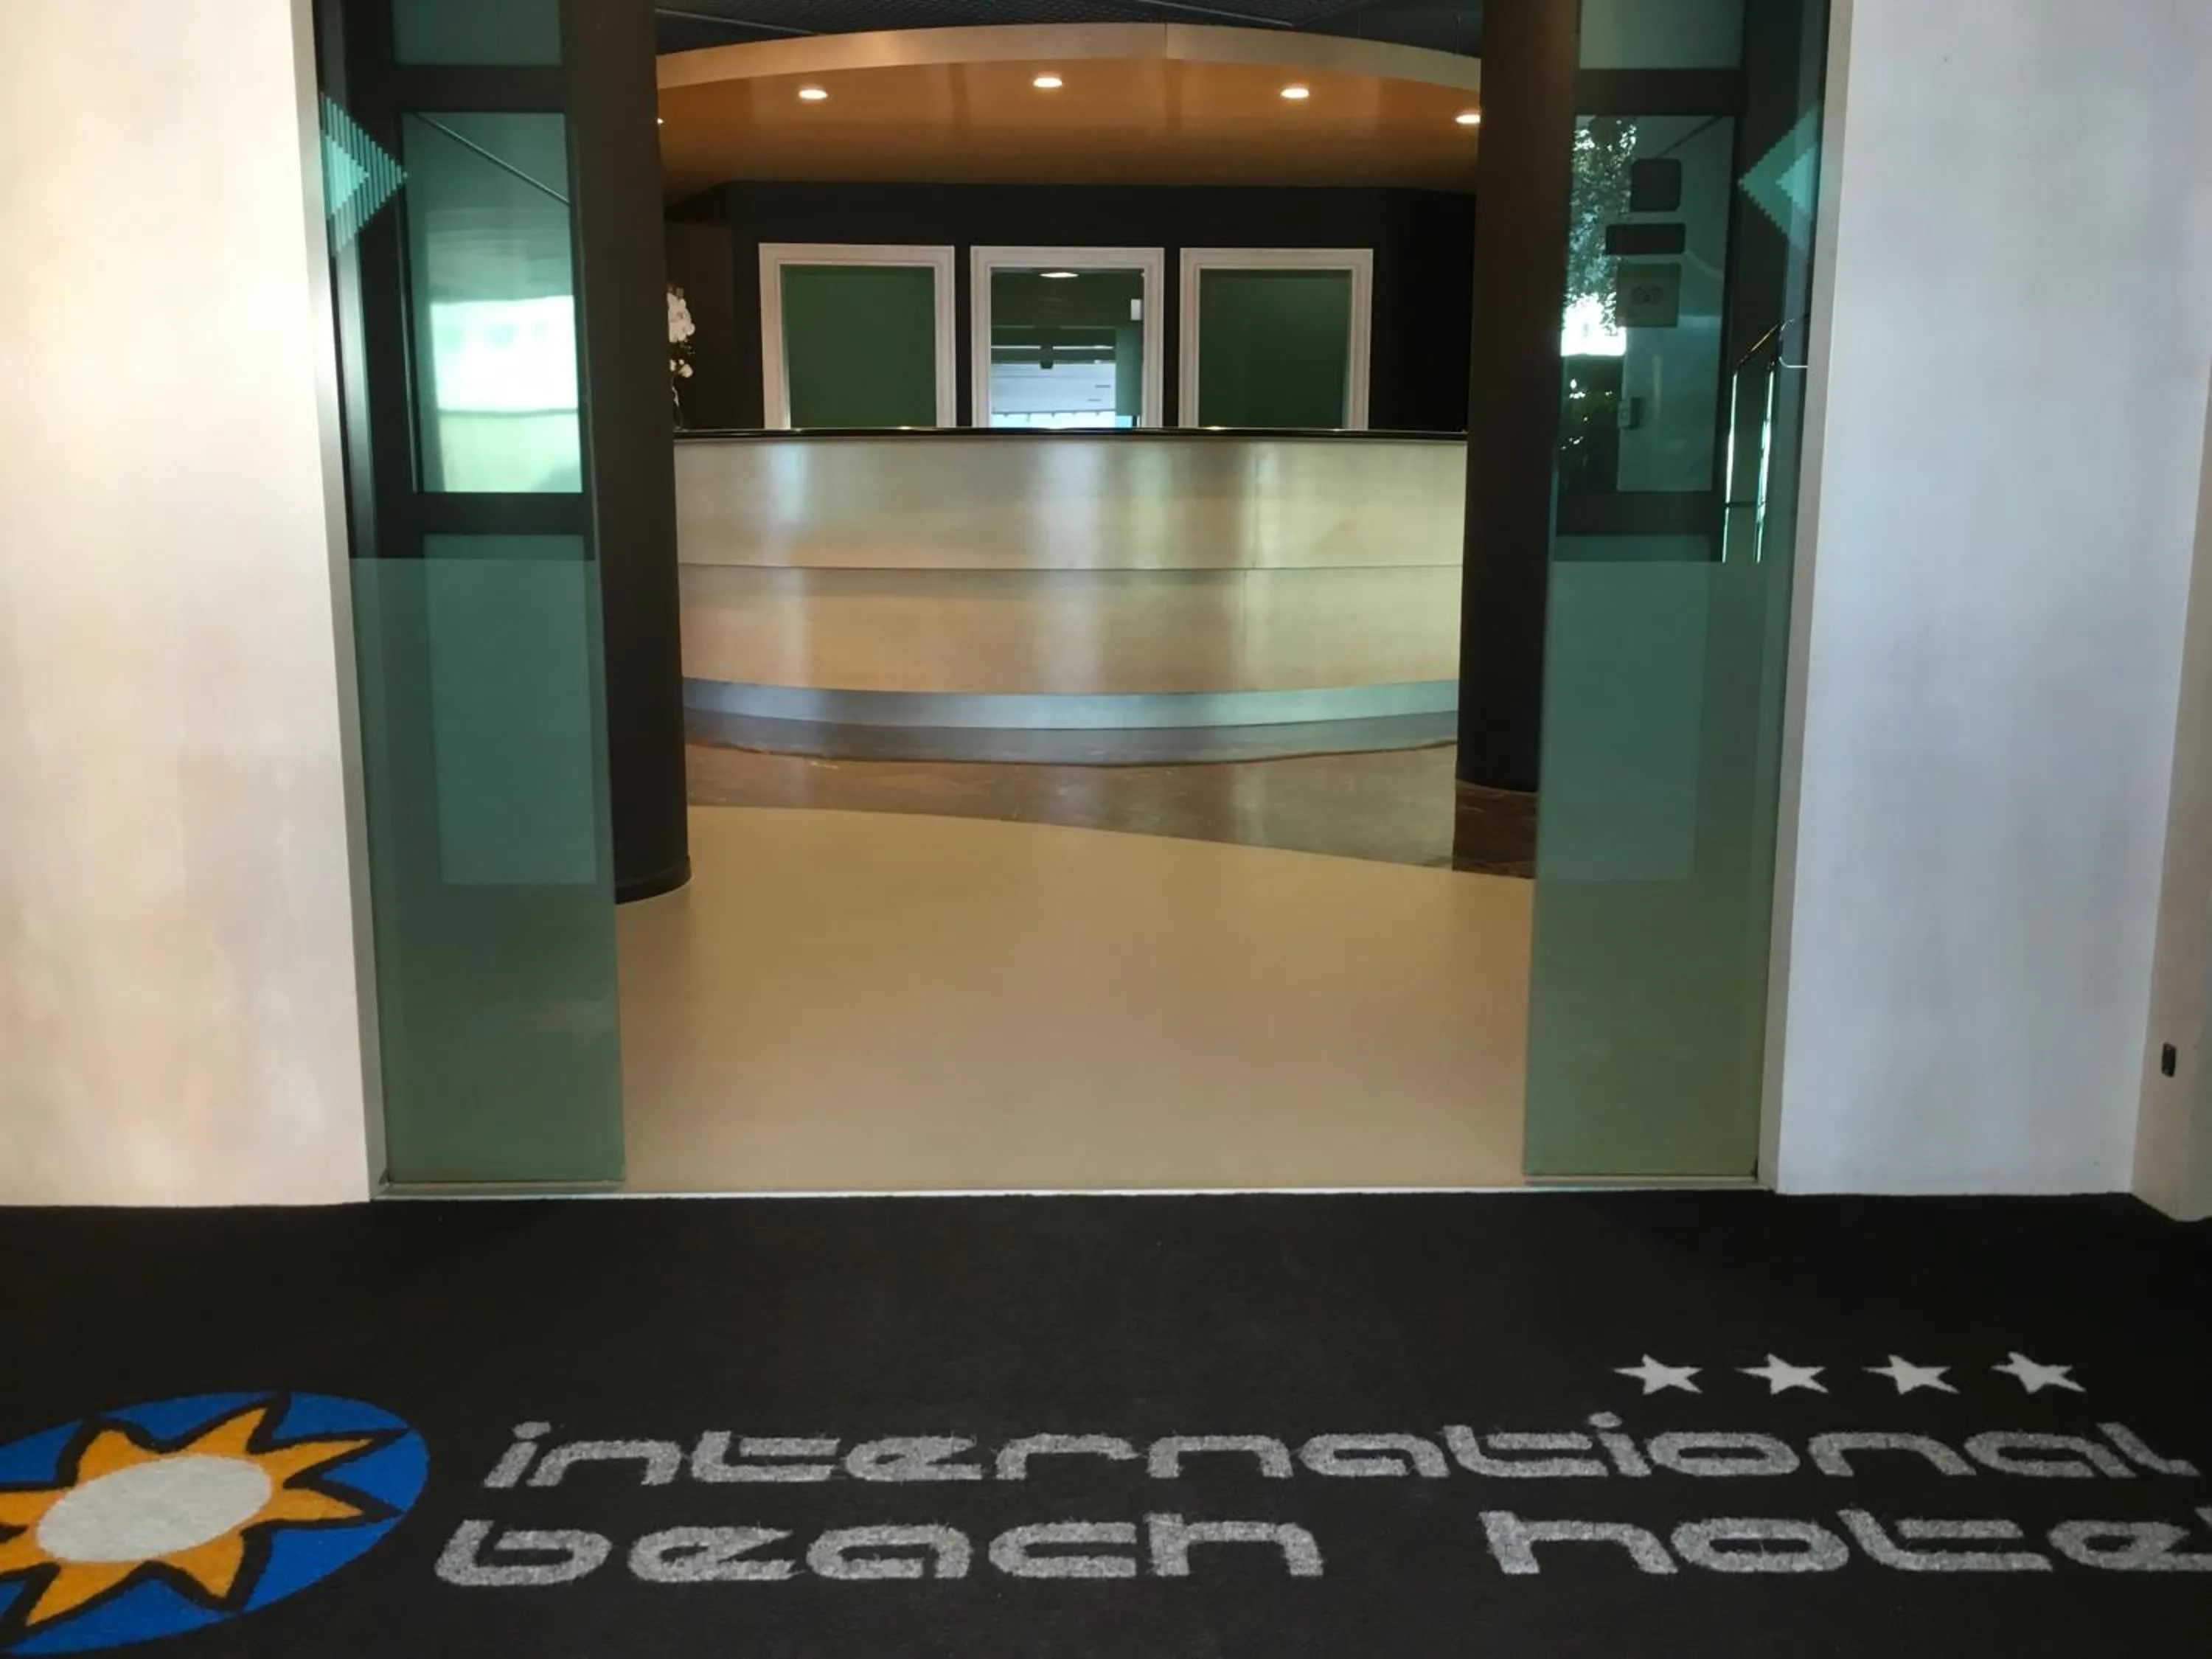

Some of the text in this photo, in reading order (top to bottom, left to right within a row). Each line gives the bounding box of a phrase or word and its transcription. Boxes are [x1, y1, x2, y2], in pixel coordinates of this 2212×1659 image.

[483, 1411, 2200, 1487] international
[435, 1508, 2212, 1586] beach hote
